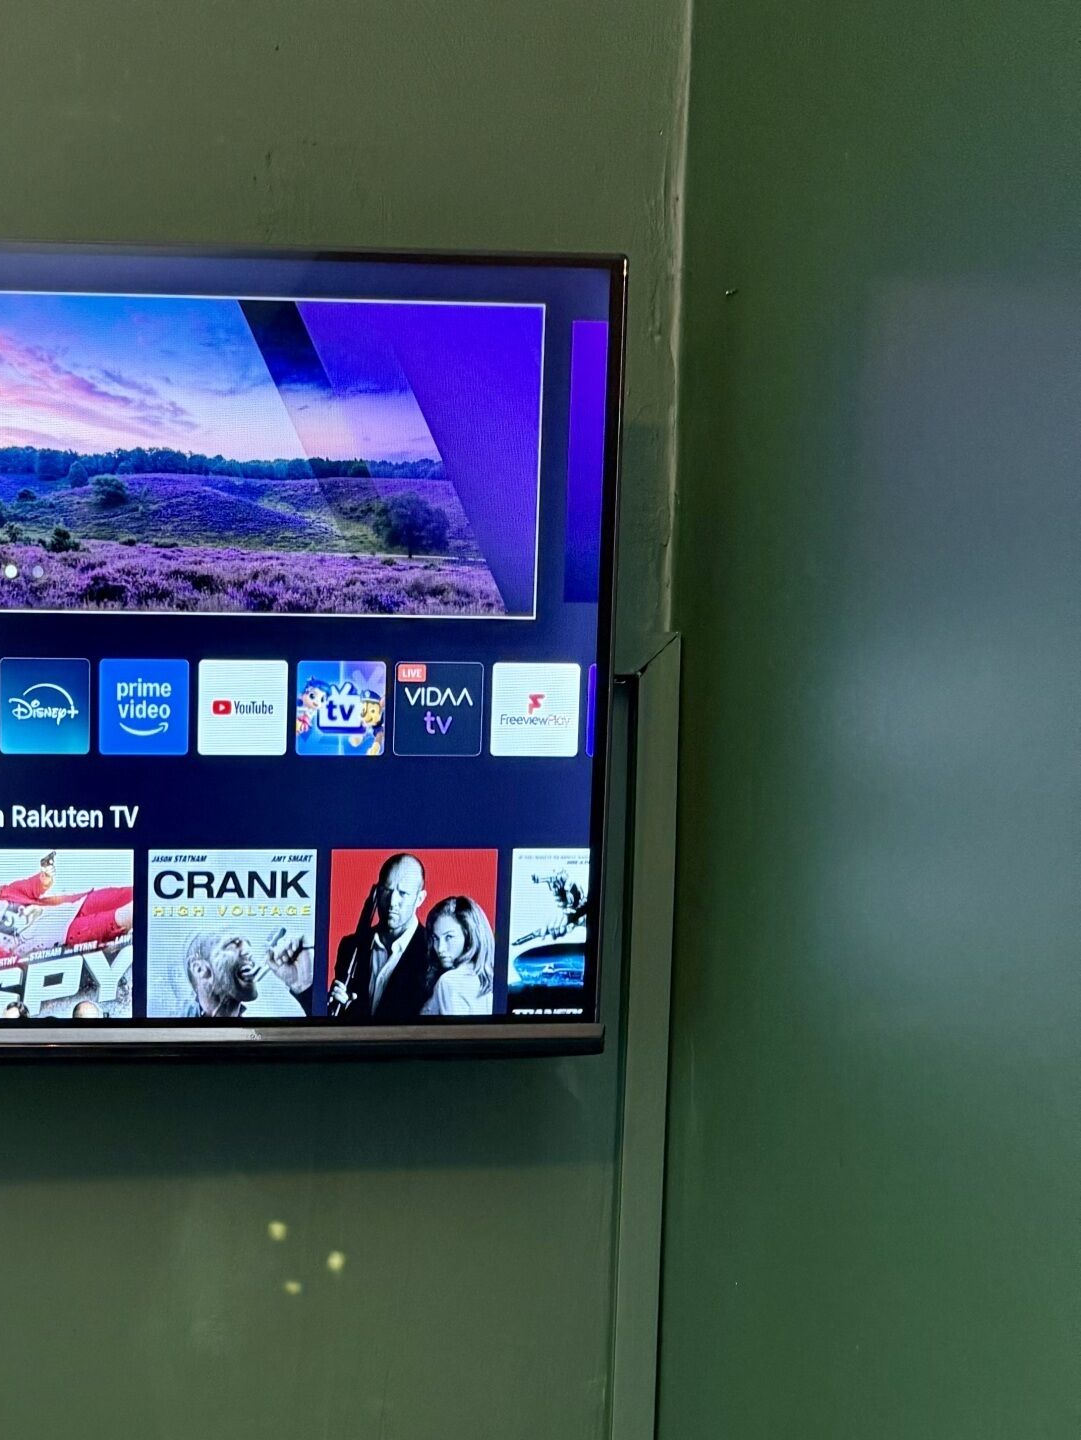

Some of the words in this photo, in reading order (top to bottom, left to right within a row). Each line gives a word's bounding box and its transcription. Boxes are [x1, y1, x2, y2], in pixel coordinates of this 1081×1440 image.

[402, 668, 422, 678] LIVE
[116, 677, 172, 701] prime
[404, 687, 473, 706] VIDAA
[118, 699, 171, 719] video
[233, 700, 274, 715] YouTube
[326, 700, 355, 721] tv
[424, 711, 452, 734] tv
[12, 805, 103, 828] Rakuten
[110, 806, 139, 828] TV
[174, 855, 207, 863] STATHAM
[271, 855, 286, 863] AMY
[287, 854, 313, 863] SMART
[153, 870, 310, 899] CRANK
[153, 905, 205, 917] HIGH
[218, 905, 311, 917] VOLTAGE
